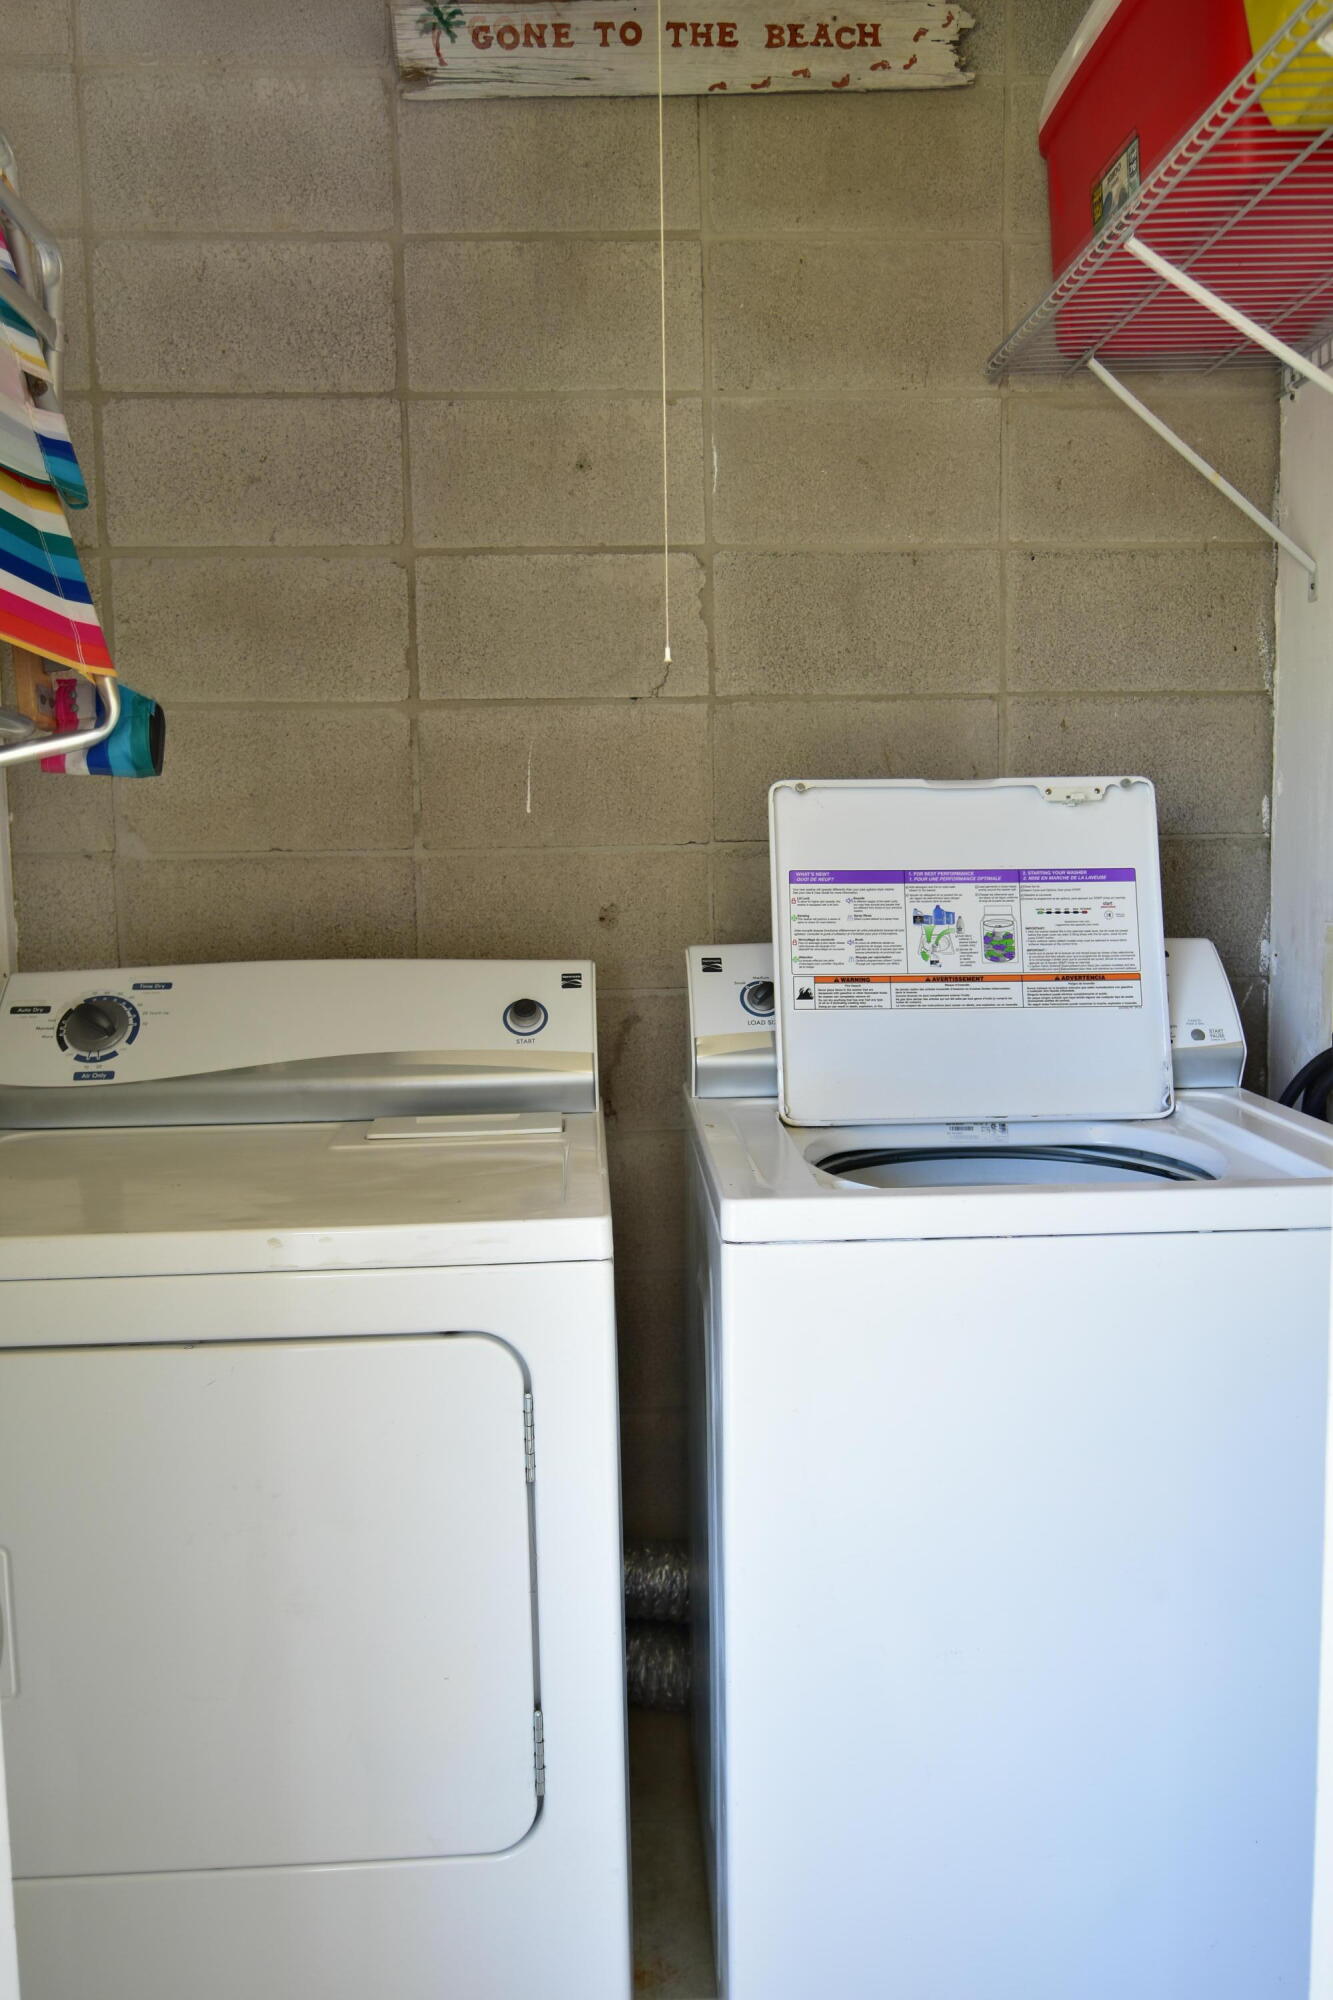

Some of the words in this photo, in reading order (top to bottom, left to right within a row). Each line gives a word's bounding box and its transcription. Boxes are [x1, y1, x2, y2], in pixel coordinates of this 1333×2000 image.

[472, 23, 575, 50] GONE
[594, 21, 642, 47] TO
[665, 21, 739, 48] THE
[765, 23, 882, 50] BEACH
